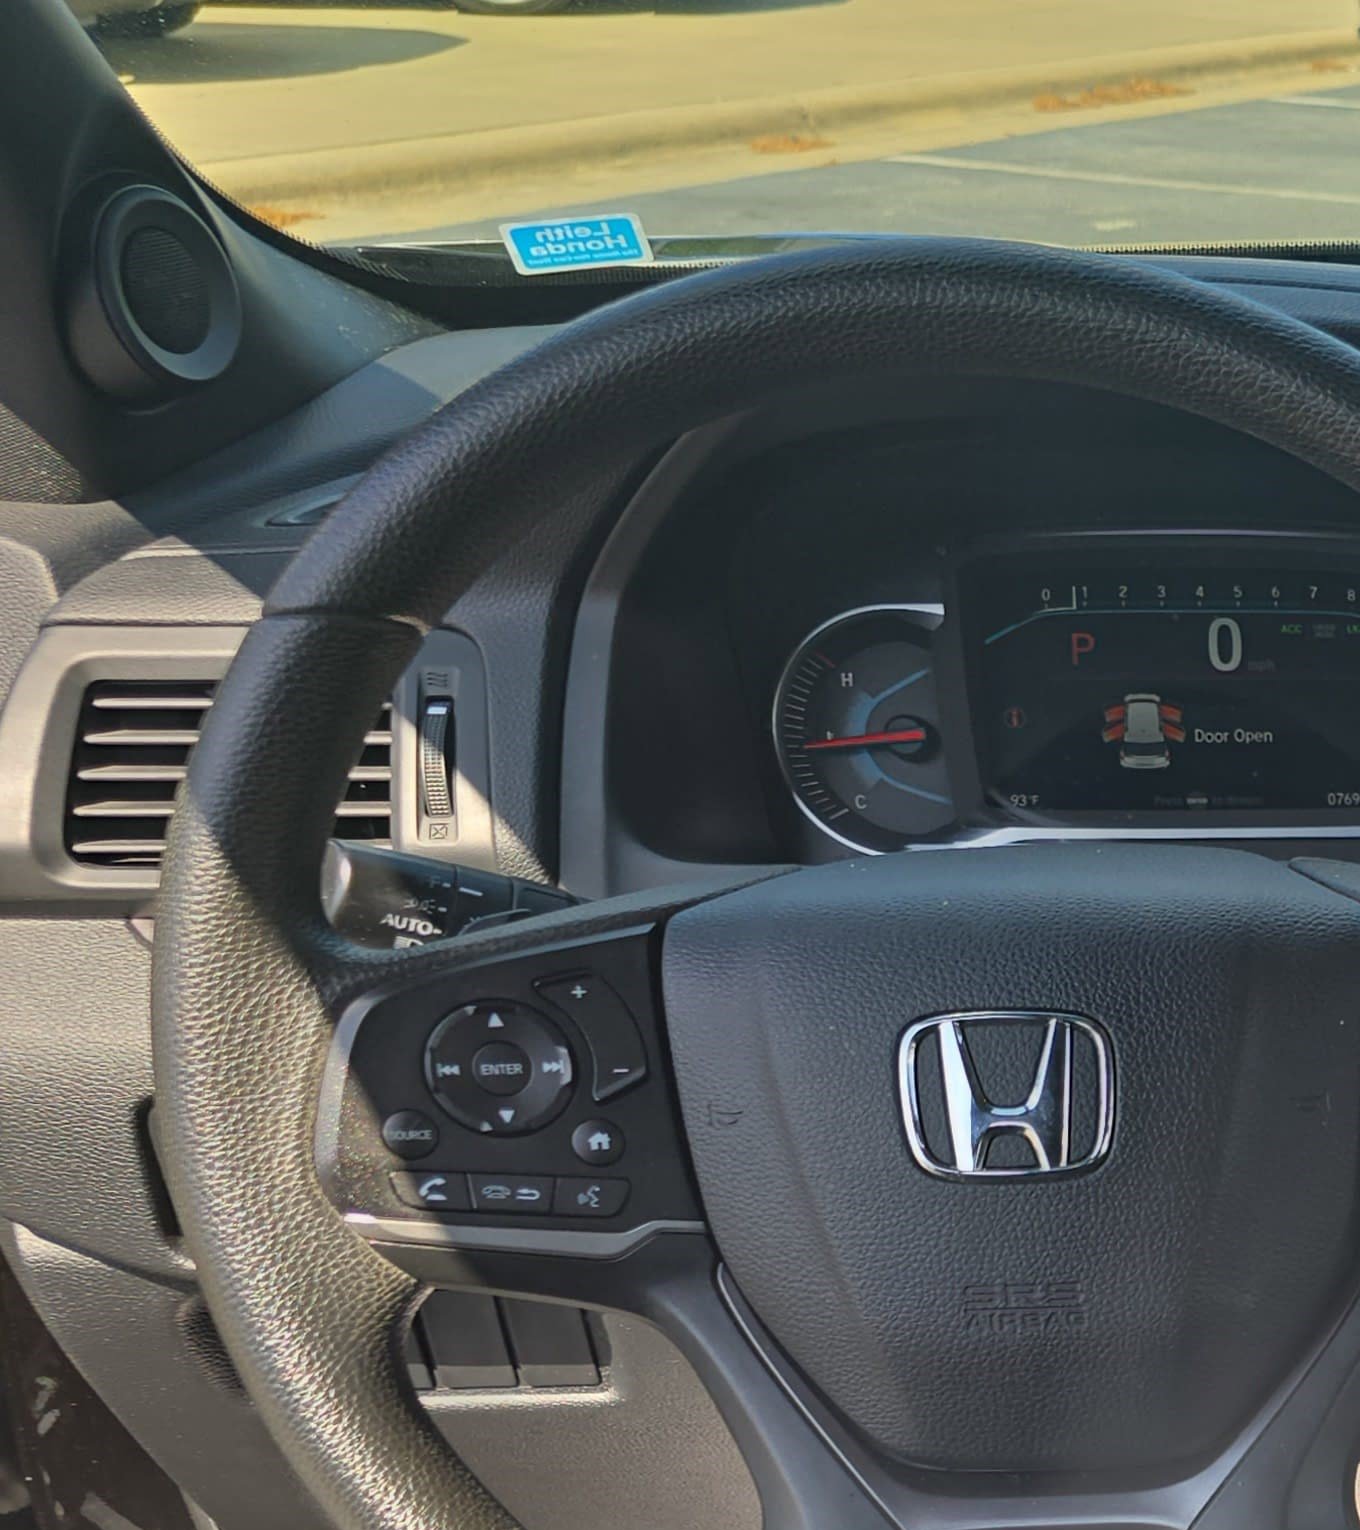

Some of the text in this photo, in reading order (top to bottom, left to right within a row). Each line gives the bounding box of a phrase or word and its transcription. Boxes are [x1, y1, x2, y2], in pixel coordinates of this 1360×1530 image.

[1119, 586, 1127, 598] 2
[1157, 585, 1166, 598] 3
[1195, 586, 1204, 597] 4
[1233, 586, 1242, 598] 5
[1272, 586, 1280, 598] 6
[1309, 586, 1318, 599] 7
[1347, 589, 1356, 601] 8
[1071, 632, 1095, 665] P
[1208, 617, 1242, 672] 0
[841, 672, 853, 687] H
[1194, 728, 1273, 744] Door Open
[855, 794, 867, 809] C
[380, 913, 434, 936] AUTO
[479, 1063, 524, 1076] ENTER
